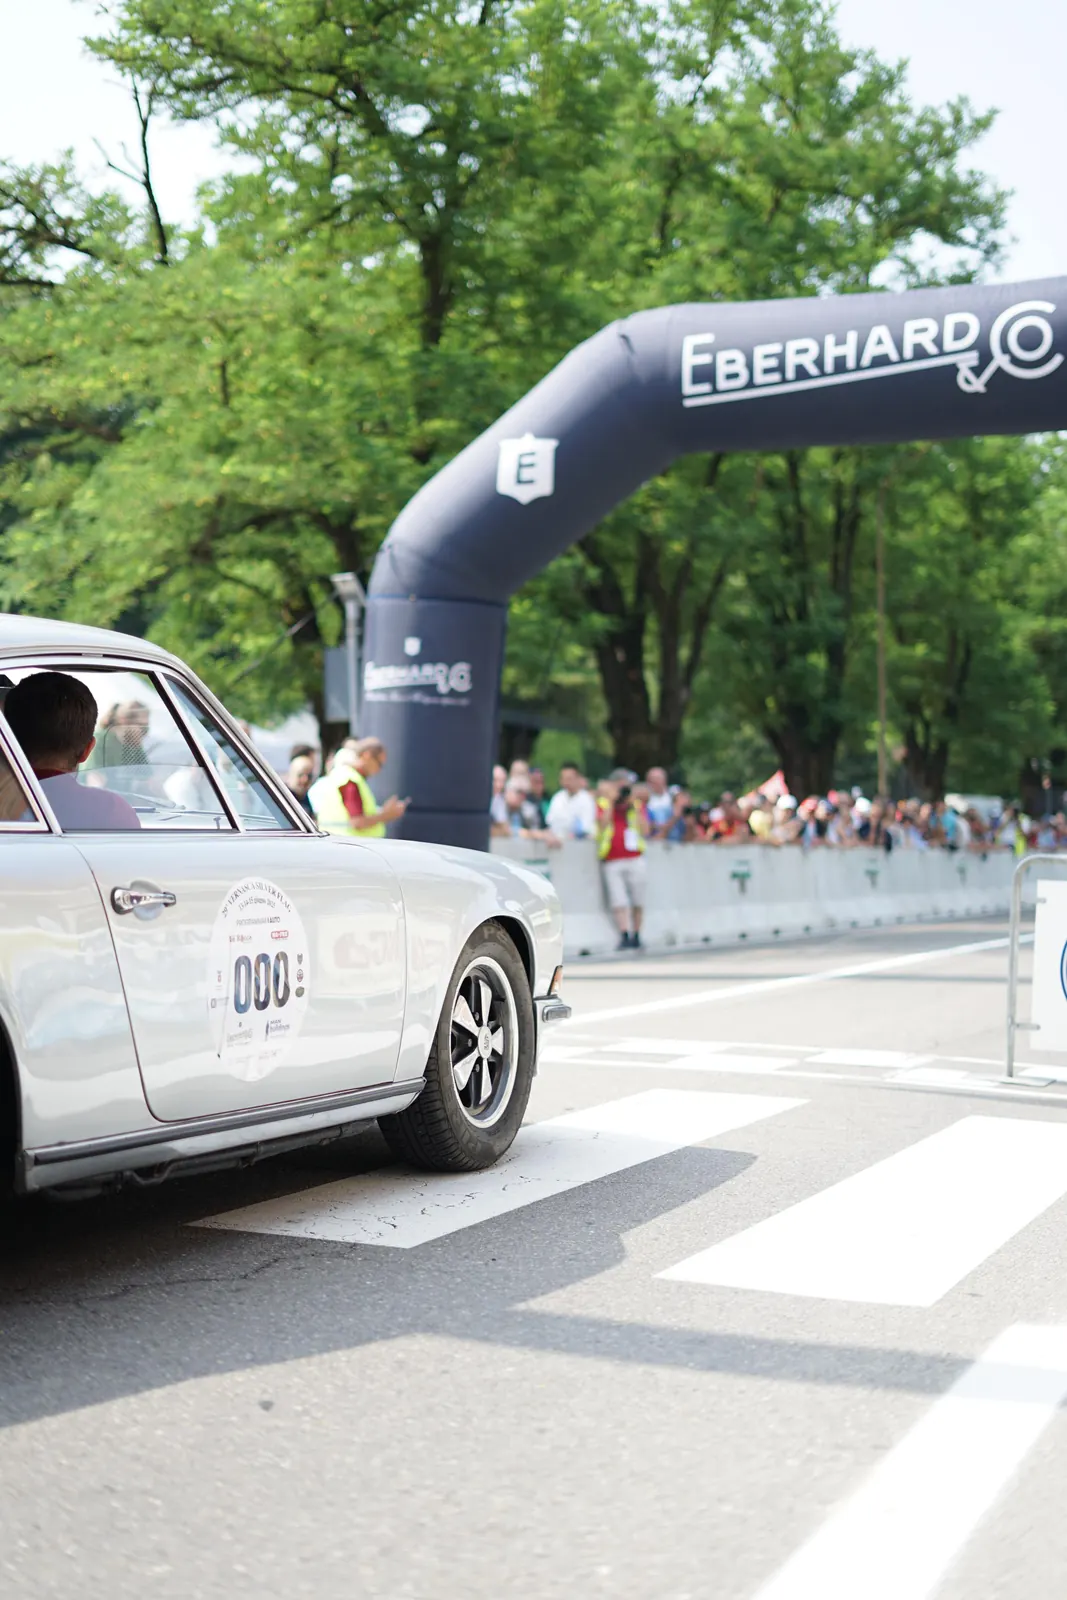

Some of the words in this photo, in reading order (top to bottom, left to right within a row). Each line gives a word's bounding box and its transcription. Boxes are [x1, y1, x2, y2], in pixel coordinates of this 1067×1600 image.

[681, 312, 981, 397] EBERHARD
[516, 451, 536, 485] E
[234, 951, 291, 1014] 000
